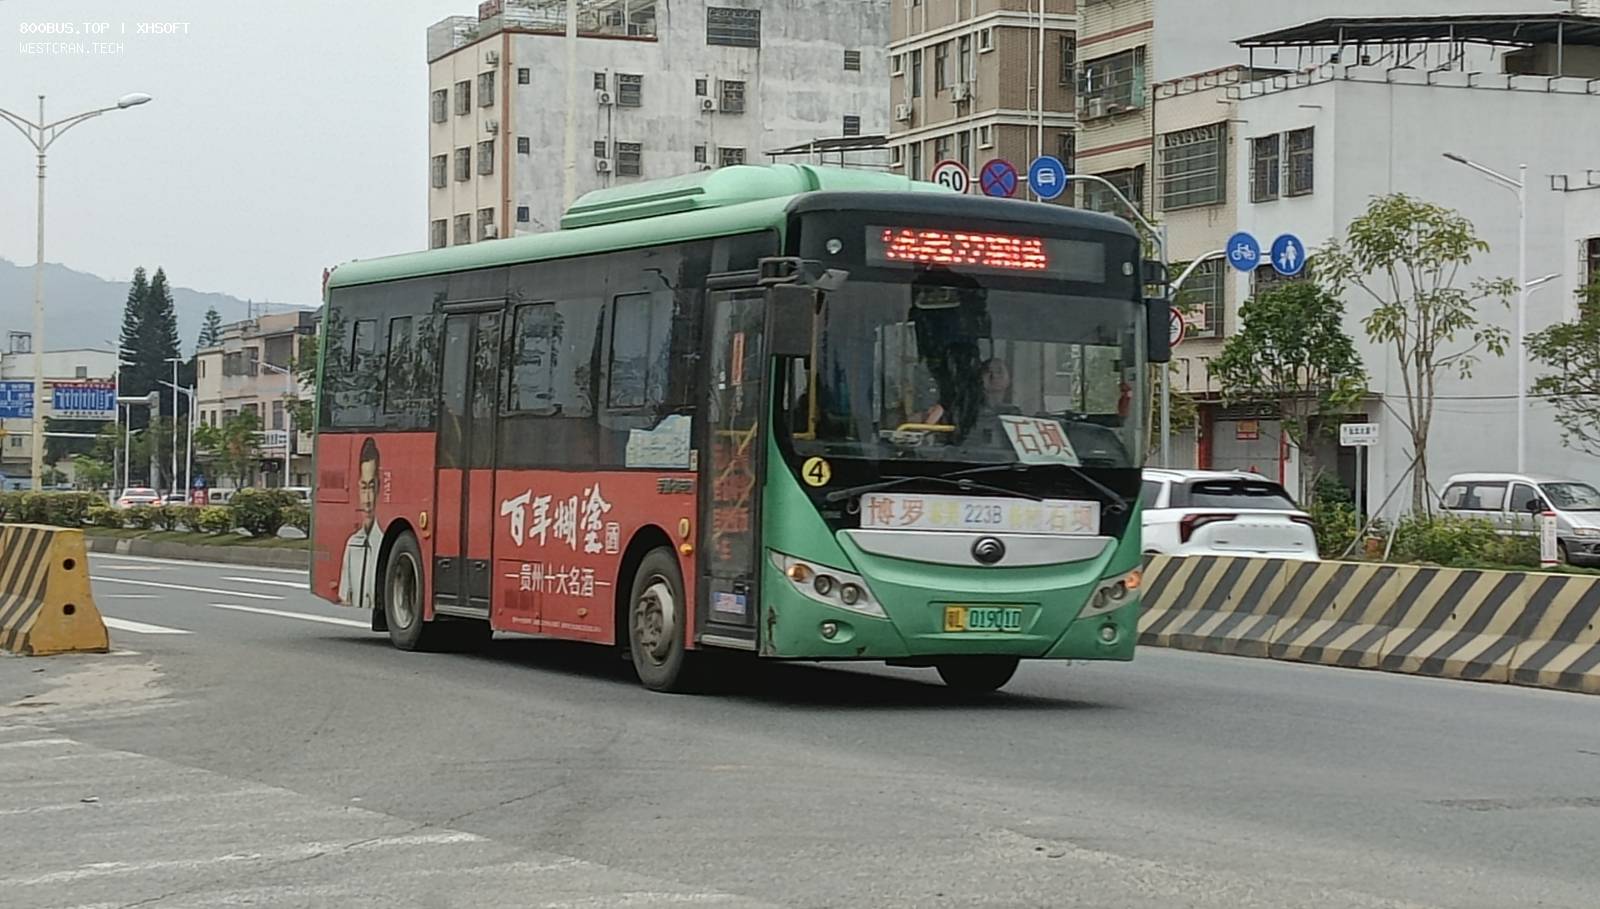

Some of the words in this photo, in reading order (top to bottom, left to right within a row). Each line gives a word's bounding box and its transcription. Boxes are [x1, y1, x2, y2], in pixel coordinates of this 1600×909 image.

[939, 170, 963, 191] 60
[1005, 420, 1073, 457] 石坝
[808, 461, 823, 483] 4
[868, 497, 924, 526] 博罗
[964, 503, 1003, 525] 223B
[520, 562, 595, 597] 贵州十大名酒
